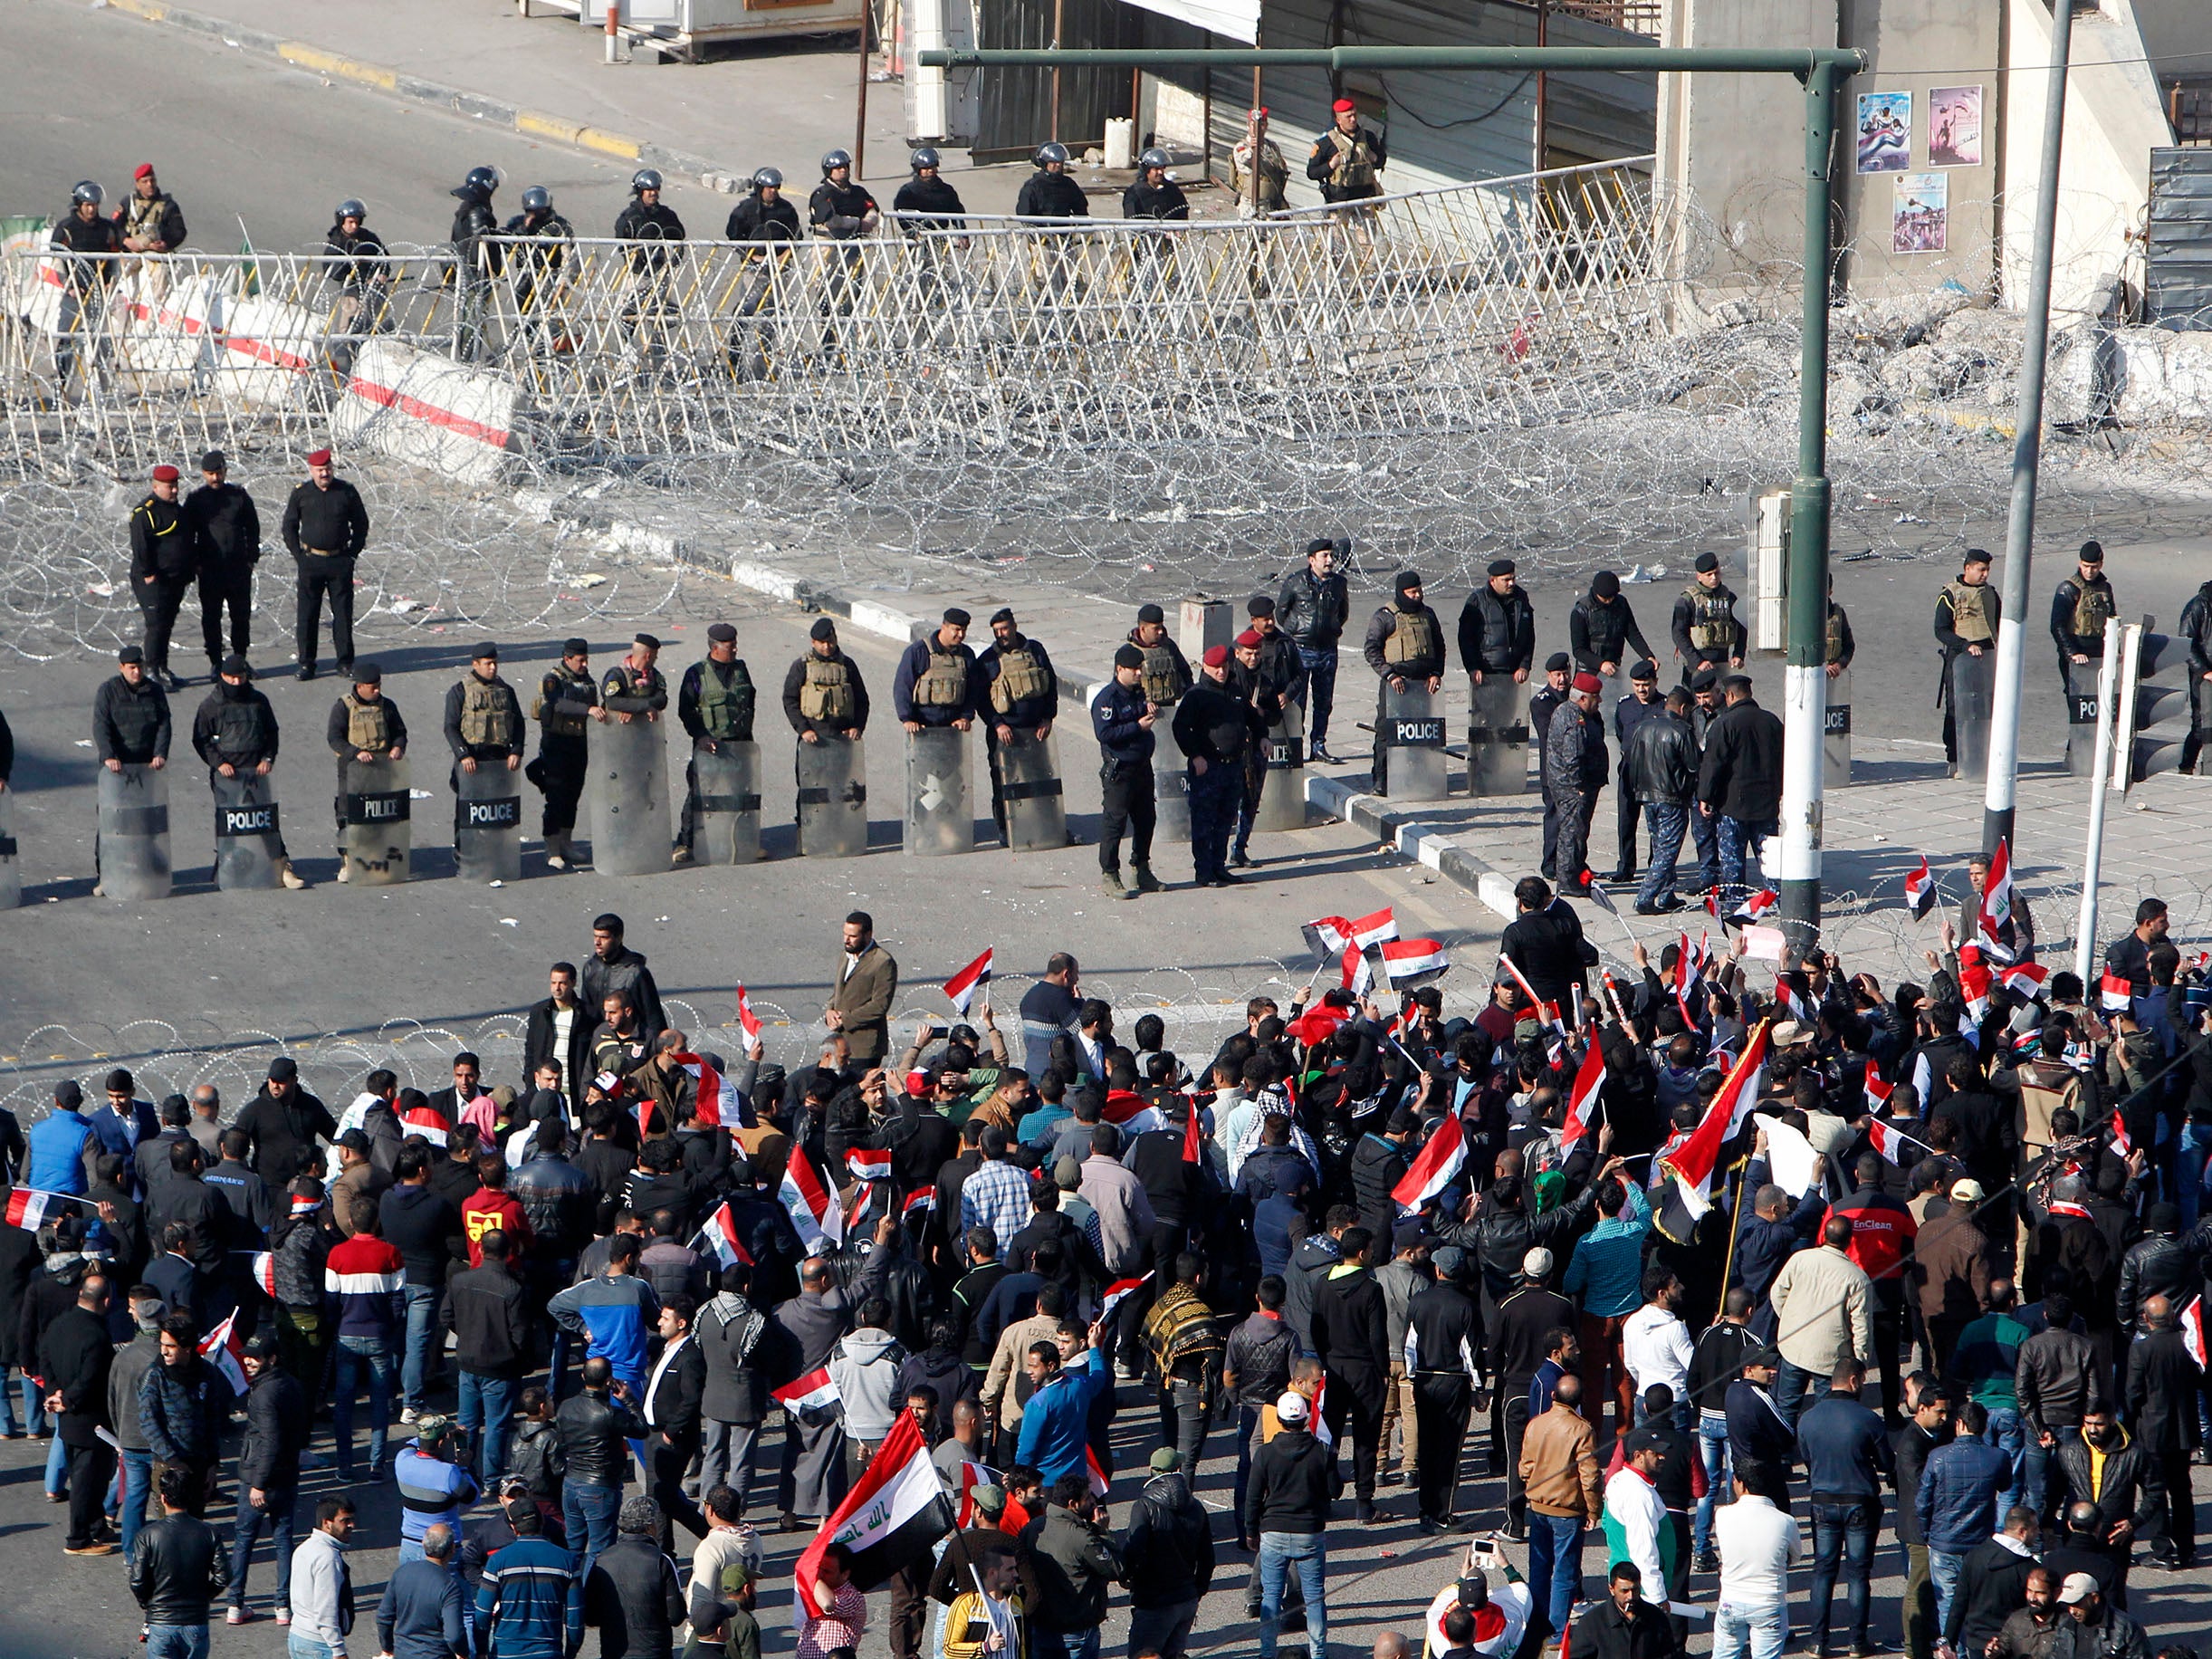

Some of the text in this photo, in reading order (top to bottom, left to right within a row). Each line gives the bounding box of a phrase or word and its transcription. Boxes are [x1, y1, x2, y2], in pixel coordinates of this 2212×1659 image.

[1397, 723, 1439, 740] POLICE
[364, 799, 398, 818] POLICE
[470, 803, 513, 822] POLICE
[226, 810, 272, 830] POLICE
[1853, 1219, 1892, 1230] EnClean
[867, 1500, 892, 1530] الله
